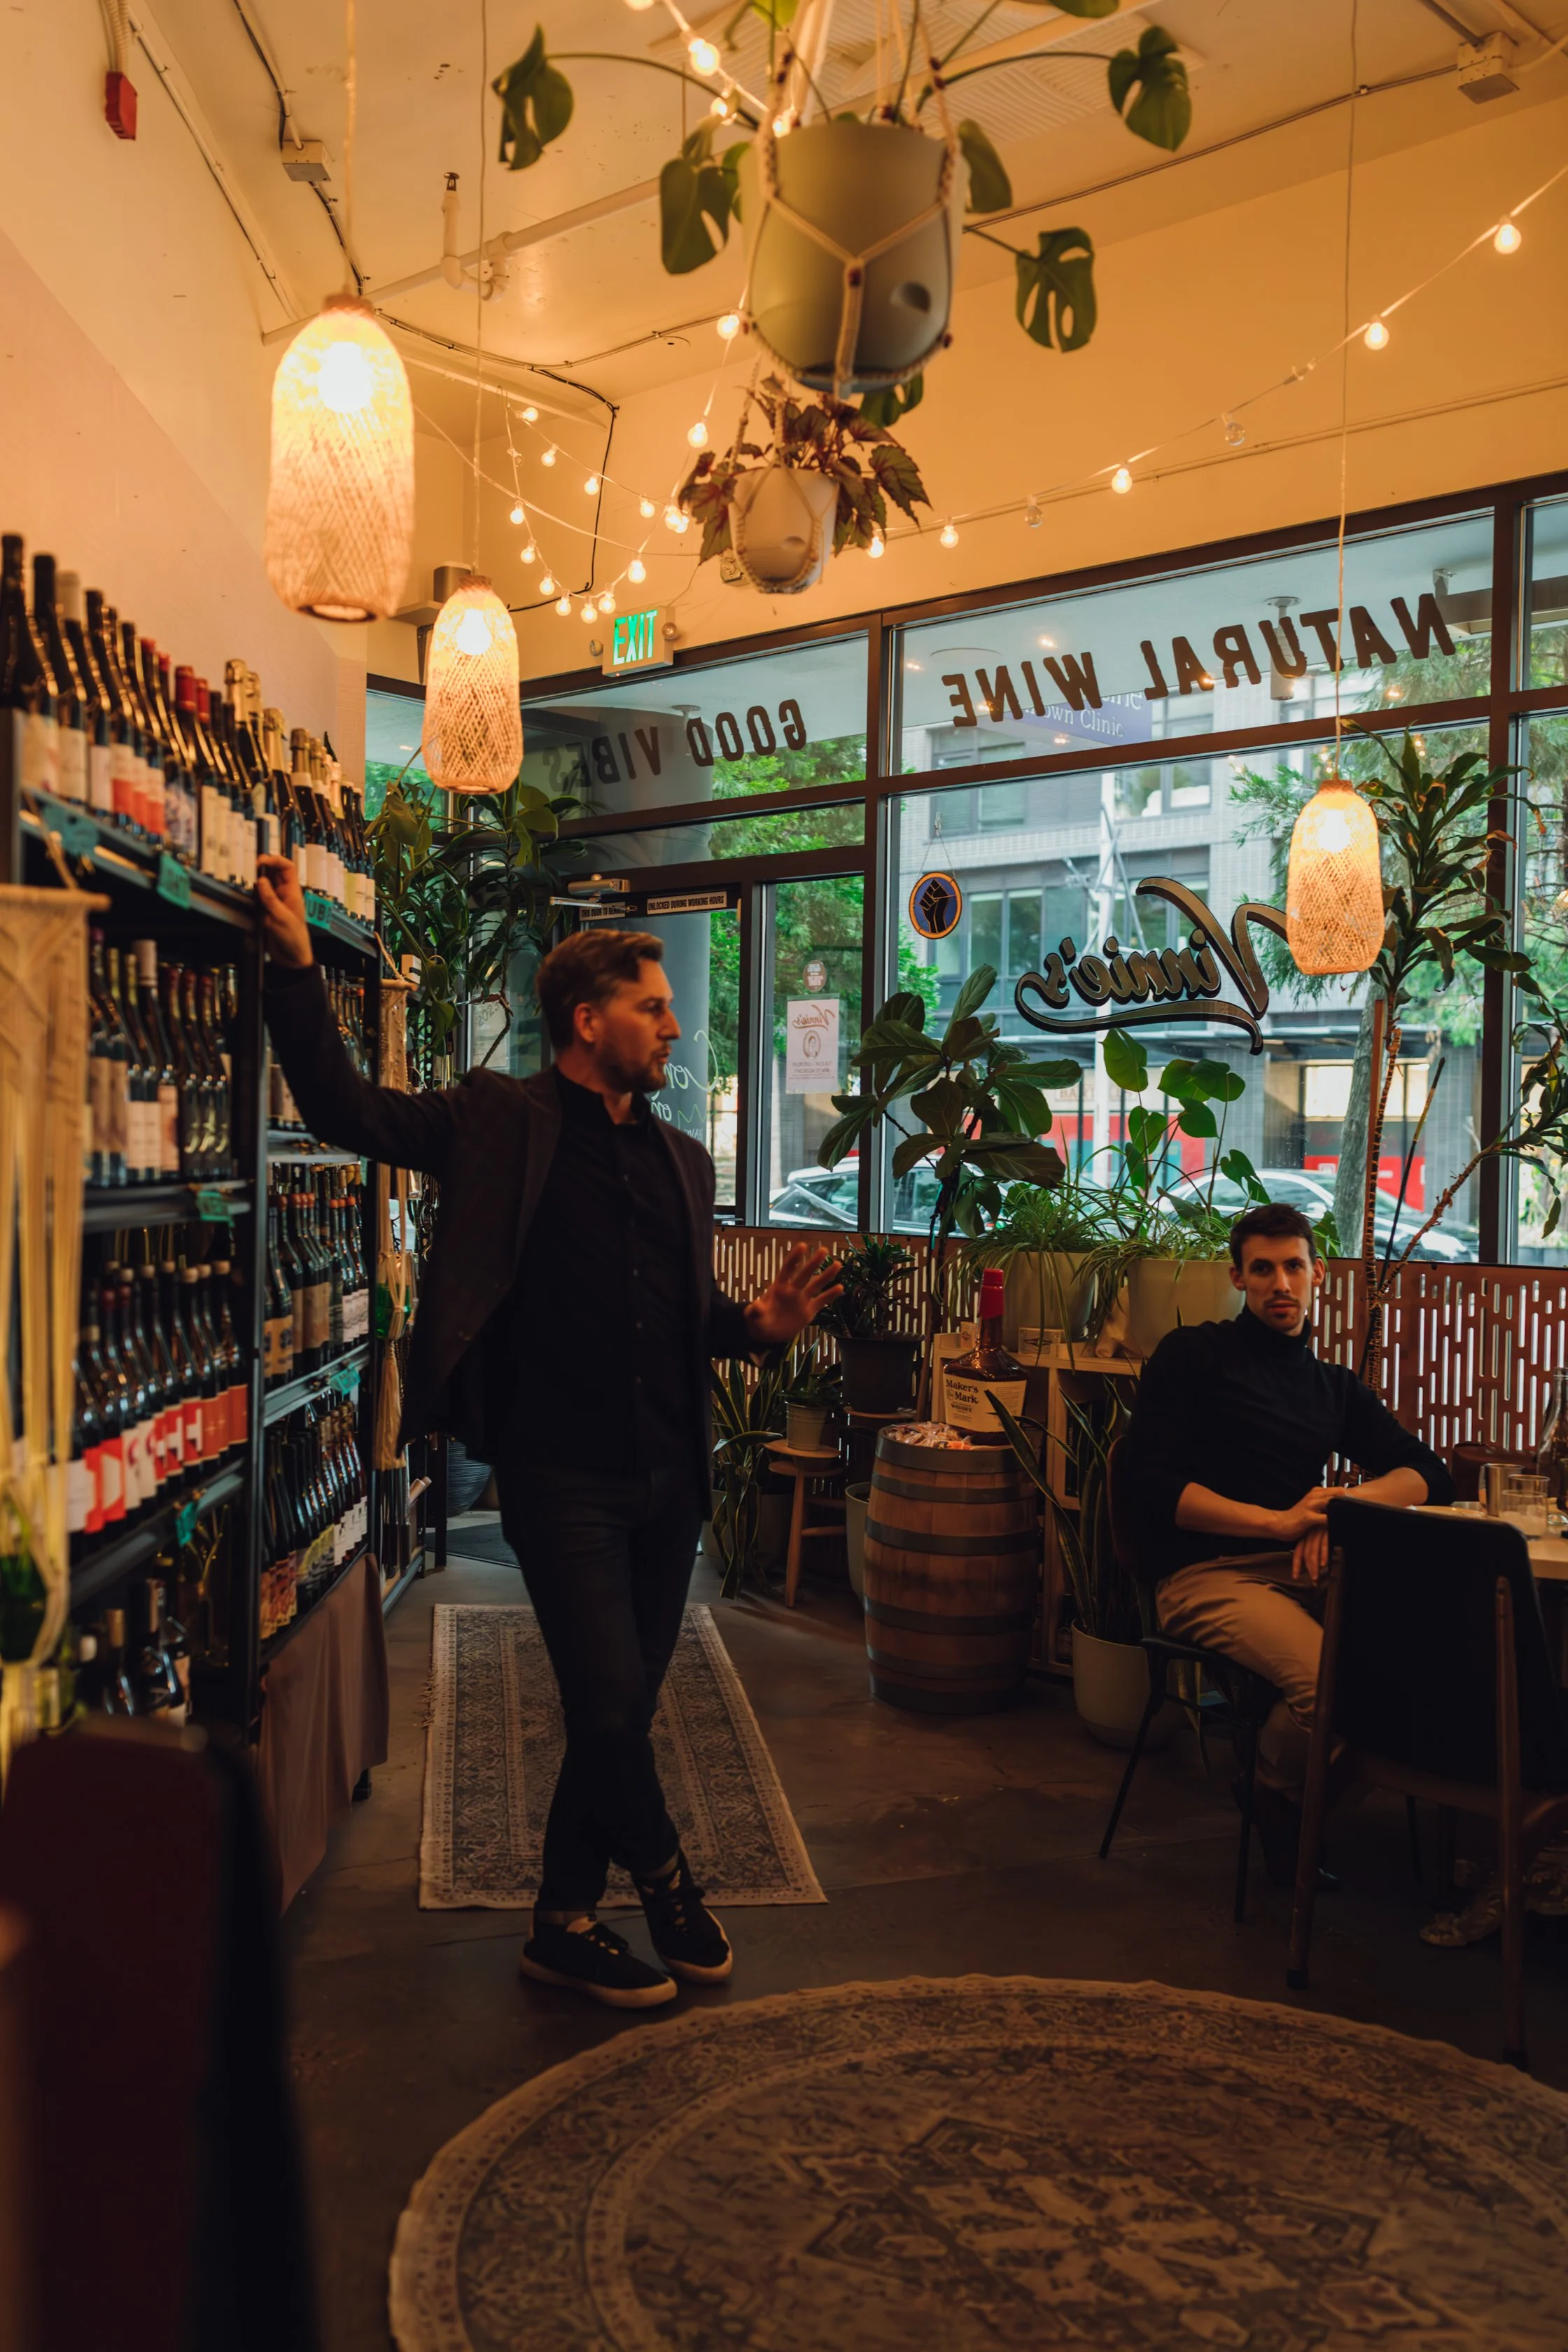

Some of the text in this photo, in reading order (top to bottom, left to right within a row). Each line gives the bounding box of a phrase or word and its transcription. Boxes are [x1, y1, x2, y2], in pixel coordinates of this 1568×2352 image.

[613, 610, 657, 666] EXIT
[1080, 709, 1125, 737] Clinic
[709, 895, 724, 904] HOURS
[946, 1380, 979, 1393] Maker's
[955, 1392, 979, 1404] Mark
